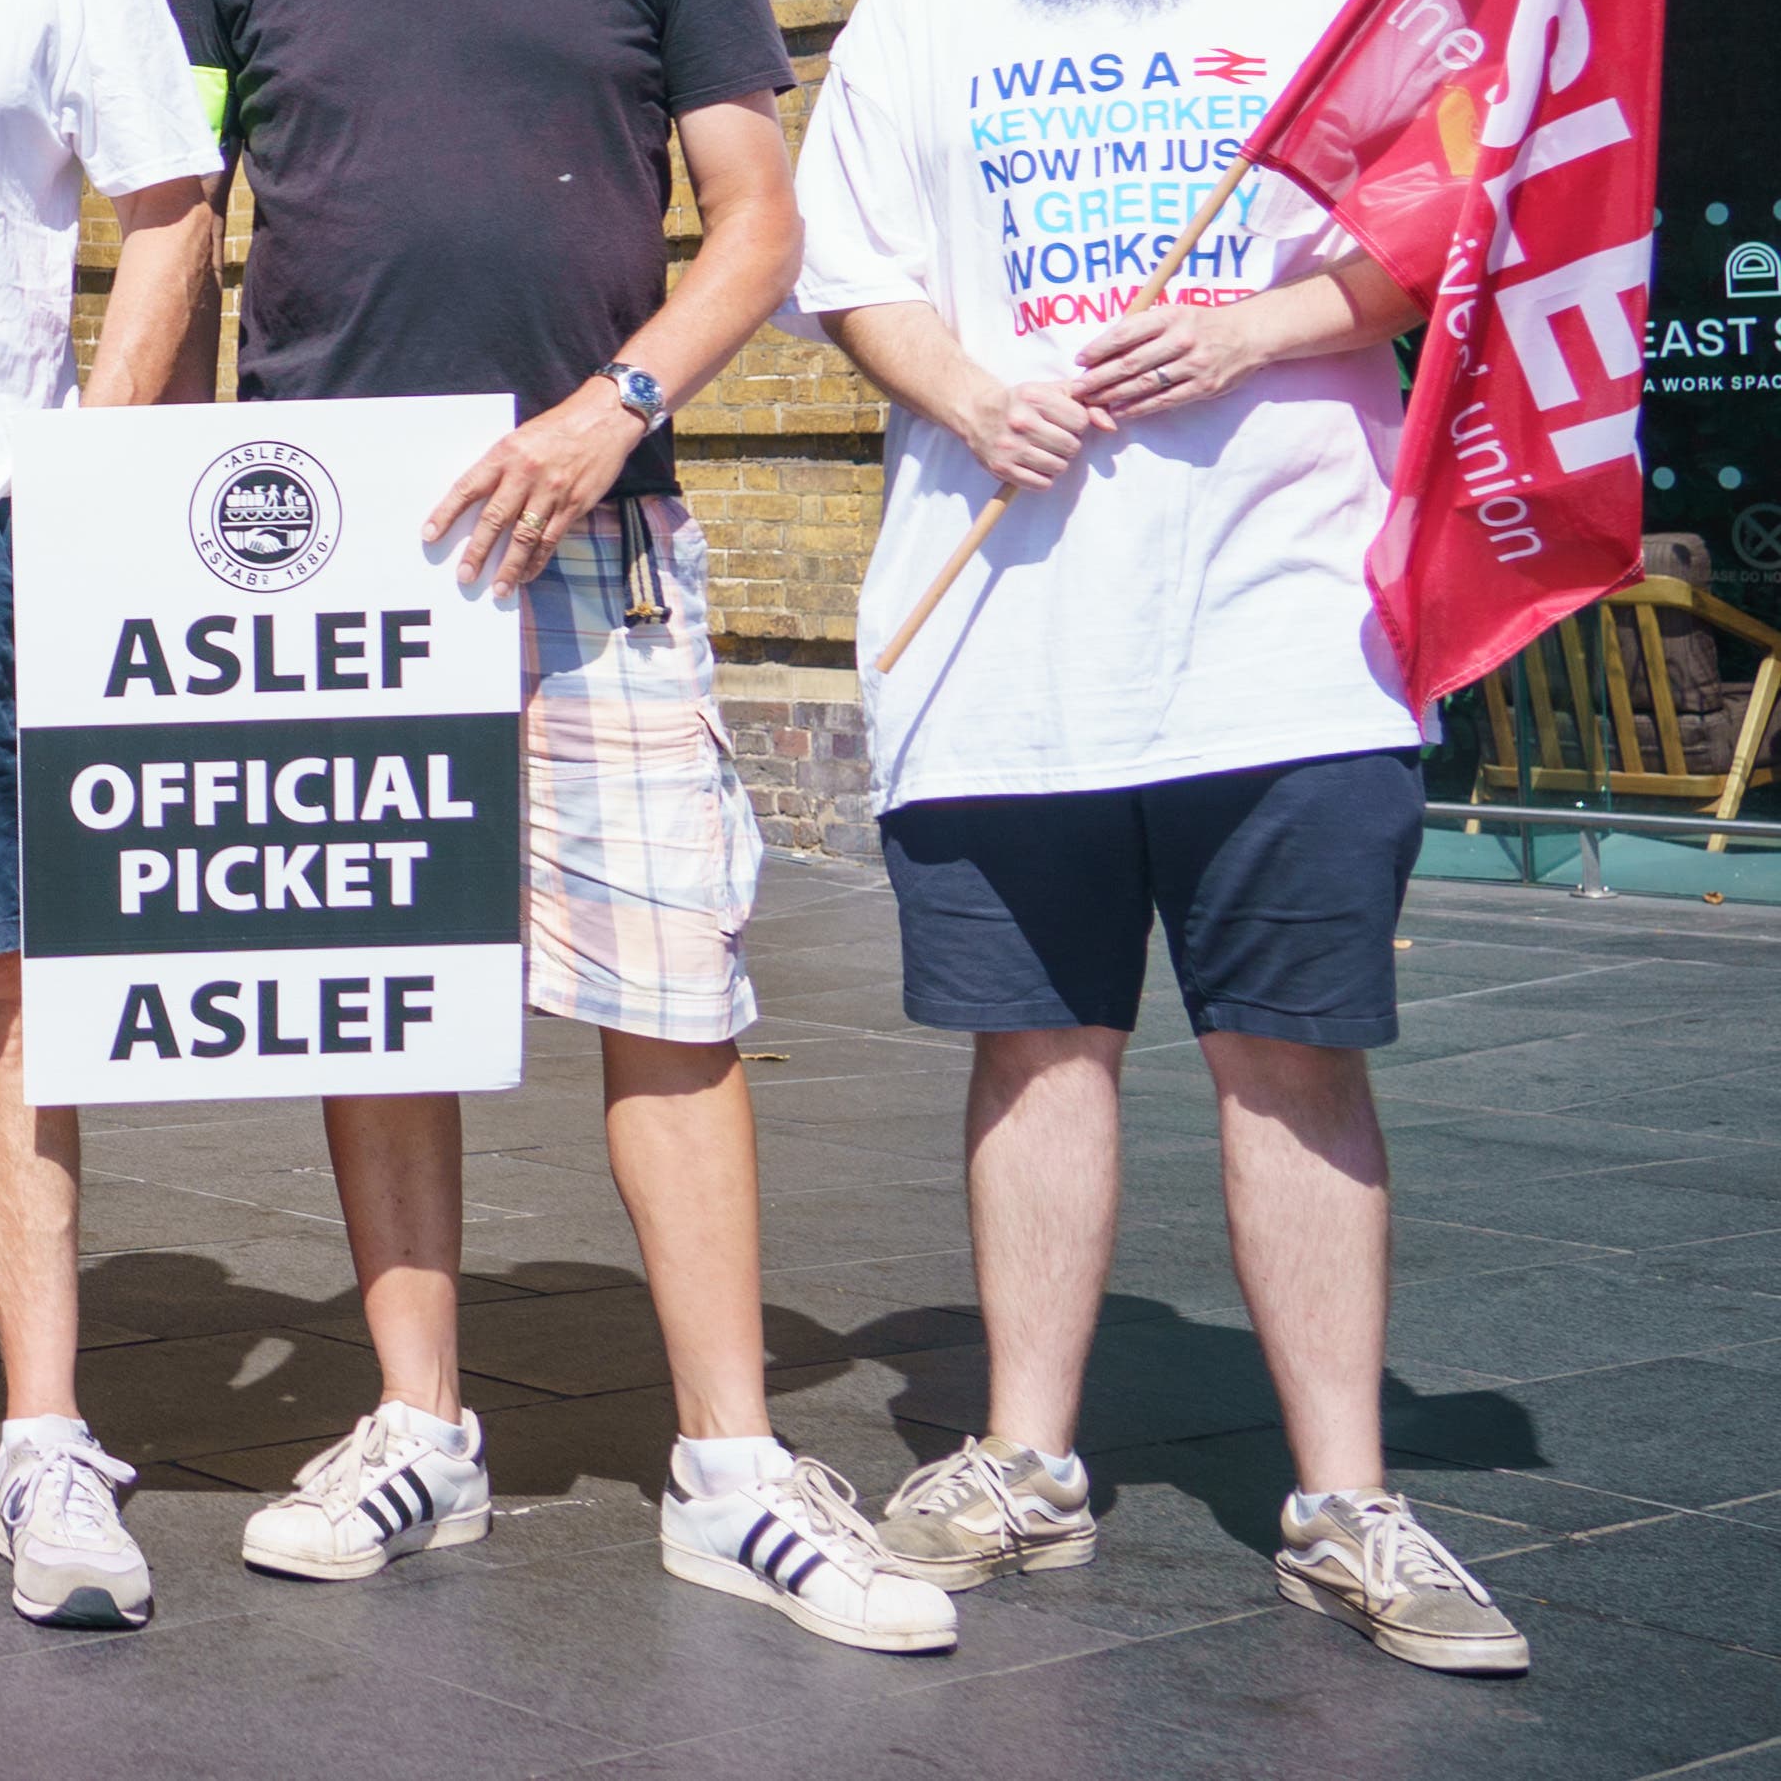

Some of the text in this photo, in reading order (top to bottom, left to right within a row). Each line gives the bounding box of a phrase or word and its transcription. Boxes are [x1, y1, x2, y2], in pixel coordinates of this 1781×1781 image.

[970, 51, 1181, 109] I WAS A
[969, 93, 1269, 151] KEYWORKER
[979, 137, 1261, 194] NOW I'M JUS
[1002, 198, 1020, 244] A
[1014, 292, 1107, 337] UNION
[1662, 376, 1724, 393] WORK
[230, 446, 300, 468] ASLEF
[1450, 400, 1543, 563] union
[285, 541, 329, 580] 1880
[103, 607, 433, 700] ASLEF
[69, 752, 474, 832] OFFICIAL
[117, 839, 430, 916] PICKET
[108, 974, 436, 1064] ASLEF
